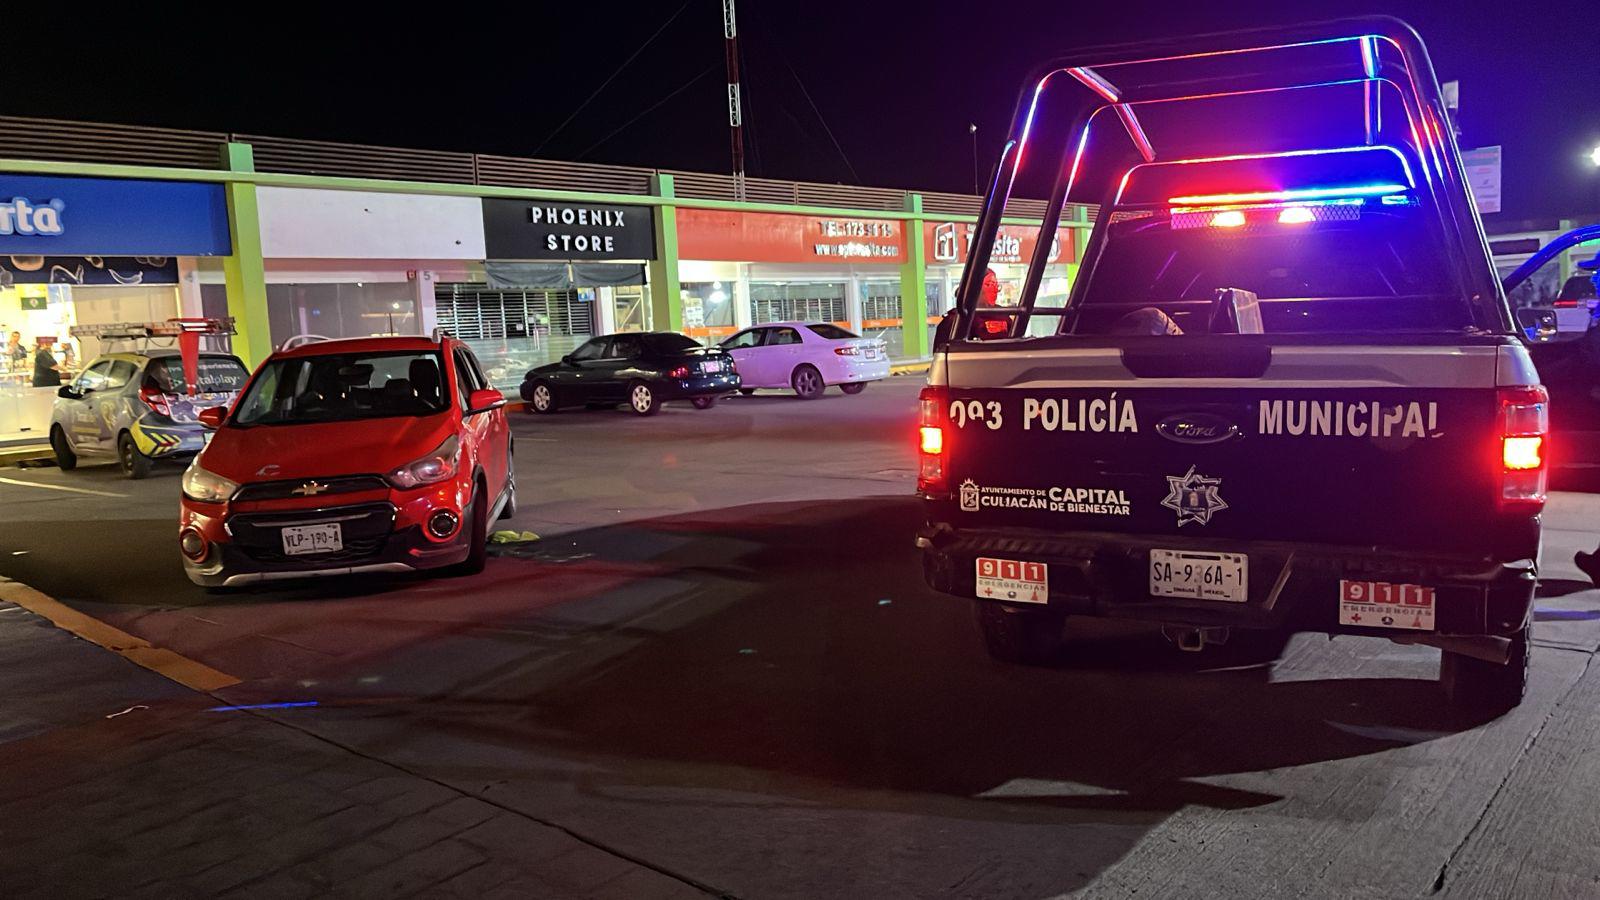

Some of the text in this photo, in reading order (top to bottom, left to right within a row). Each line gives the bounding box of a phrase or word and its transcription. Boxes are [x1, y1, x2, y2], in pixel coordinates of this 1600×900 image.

[532, 206, 624, 227] PHOENIX
[547, 234, 614, 252] STORE
[423, 271, 431, 280] 5
[1024, 391, 1138, 433] POLICÍA
[1259, 400, 1444, 438] MUNICIPAL
[1174, 423, 1217, 436] Ford
[981, 487, 1035, 496] AYUNTAMIENTO
[1049, 487, 1130, 505] CAPITAL
[981, 496, 1047, 509] CULIACÁN
[1050, 502, 1130, 515] DE BIENESTAR
[983, 561, 1038, 580] 911
[979, 580, 1045, 591] EMERGENCIAS
[1350, 584, 1423, 603] 911
[1343, 605, 1432, 616] EMERGENCIAS
